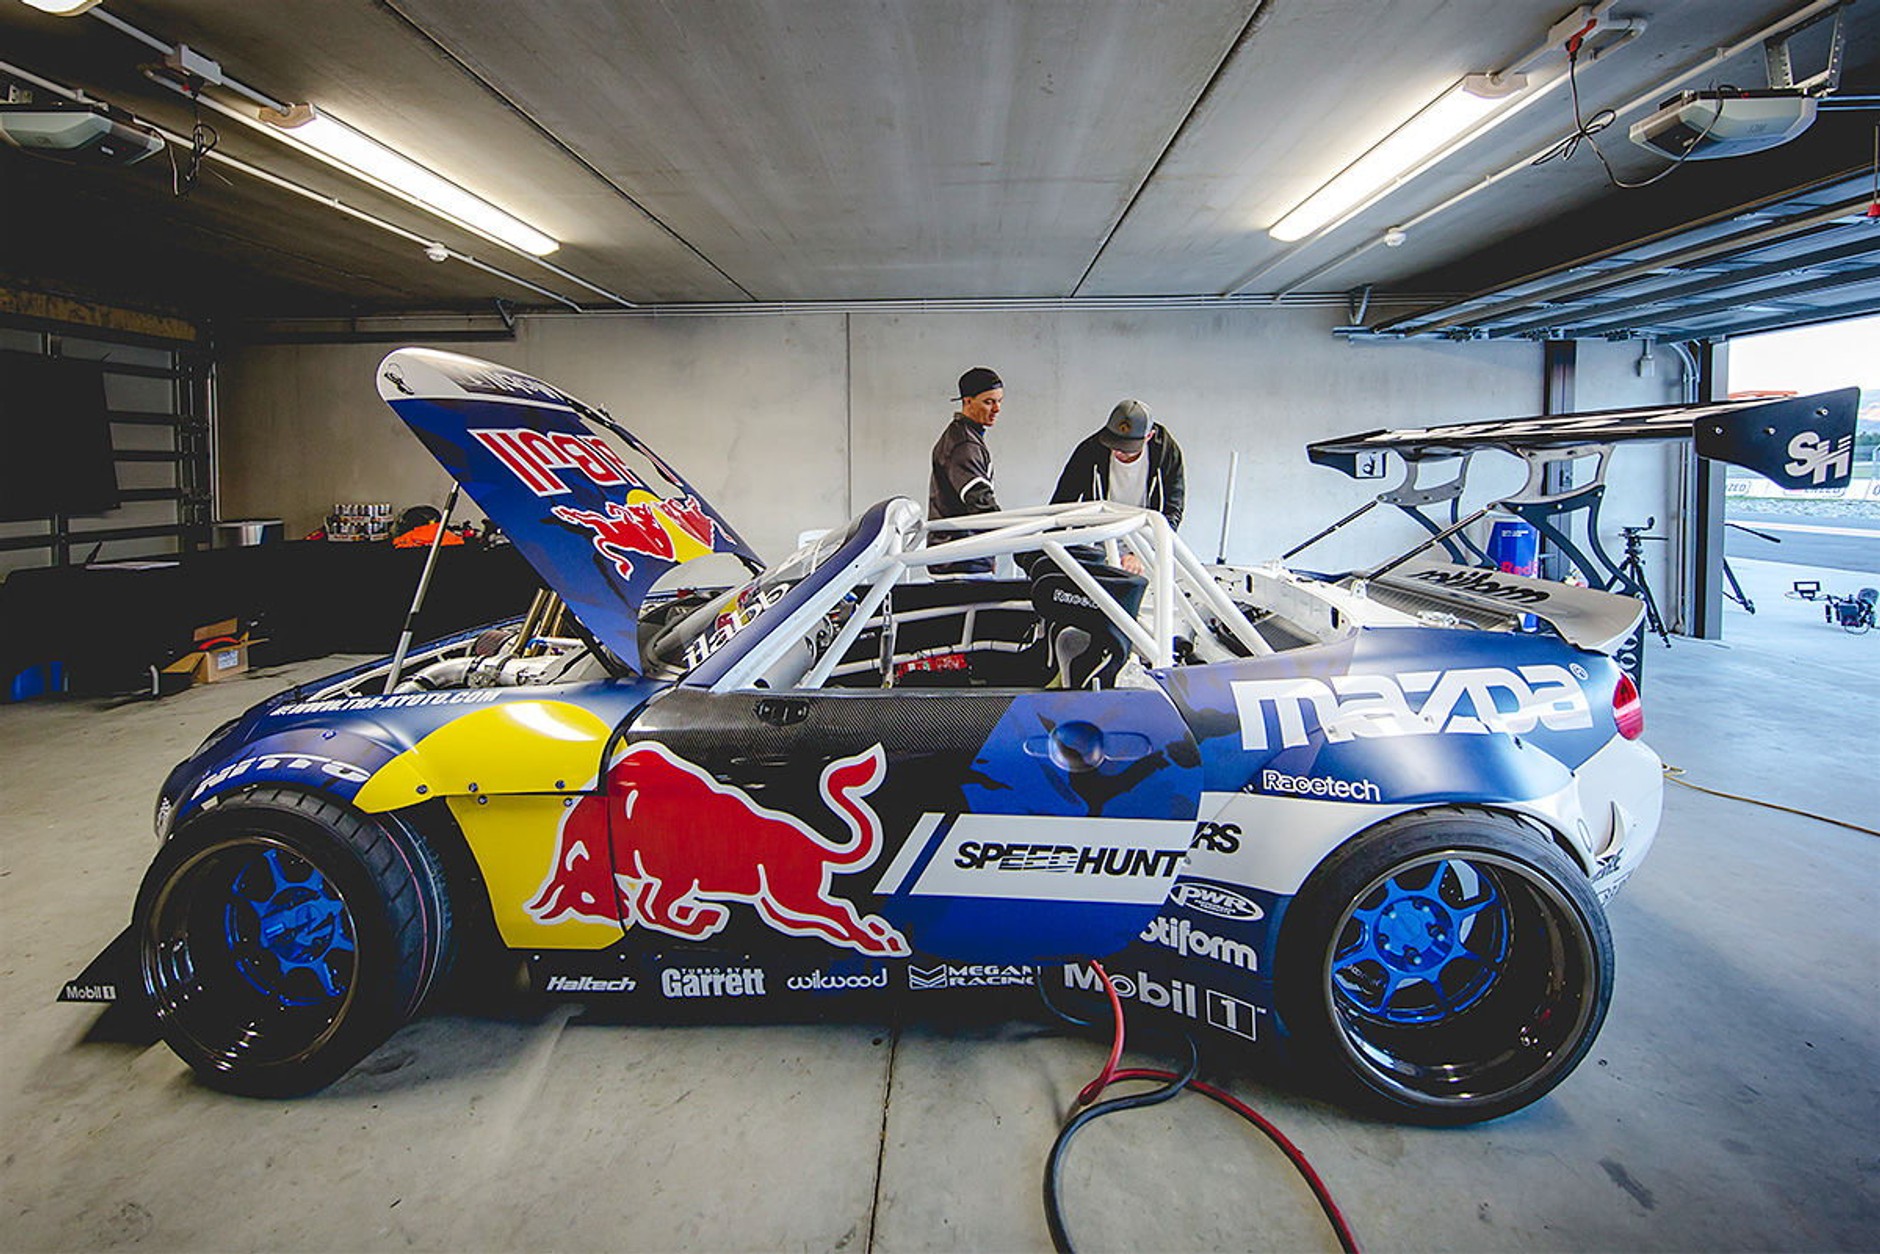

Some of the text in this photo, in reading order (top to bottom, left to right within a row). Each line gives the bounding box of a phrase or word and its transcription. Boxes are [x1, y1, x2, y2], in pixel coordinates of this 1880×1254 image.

[1784, 431, 1852, 484] SH
[191, 753, 371, 800] NITTO
[1262, 769, 1381, 802] Racetech
[1178, 885, 1254, 914] PWR
[66, 985, 102, 999] Mobil
[546, 976, 637, 991] Haltech
[661, 968, 766, 997] Garrett
[787, 968, 888, 990] wilwood
[1064, 963, 1198, 1019] Mobil
